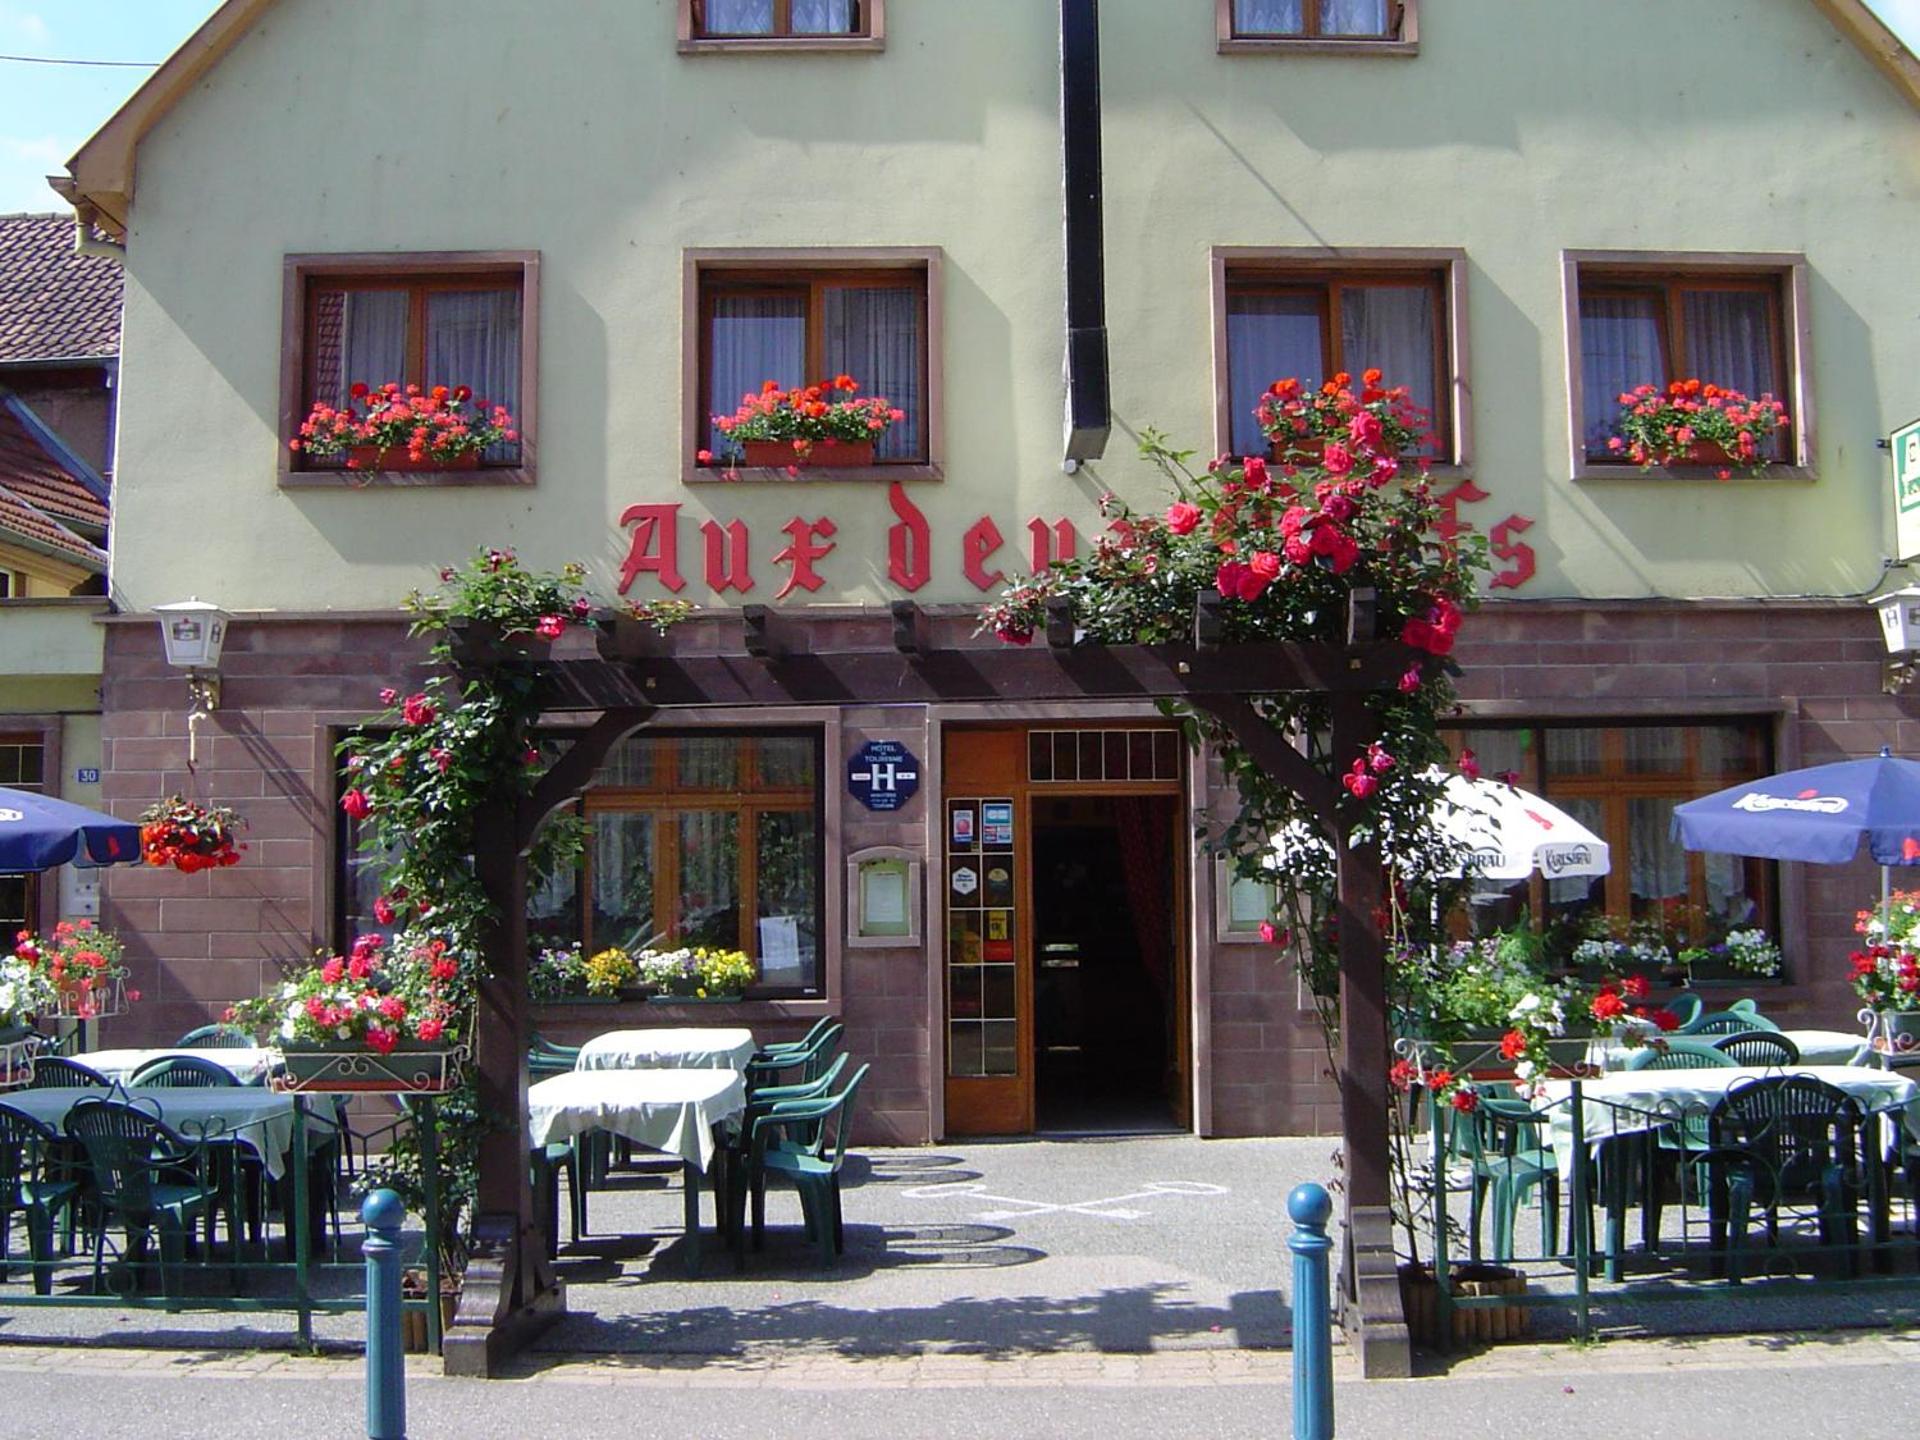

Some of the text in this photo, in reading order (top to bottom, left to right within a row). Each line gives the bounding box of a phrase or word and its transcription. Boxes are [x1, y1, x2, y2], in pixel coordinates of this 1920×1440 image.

[617, 501, 838, 600] Aux
[80, 770, 96, 783] 30
[871, 763, 896, 791] H
